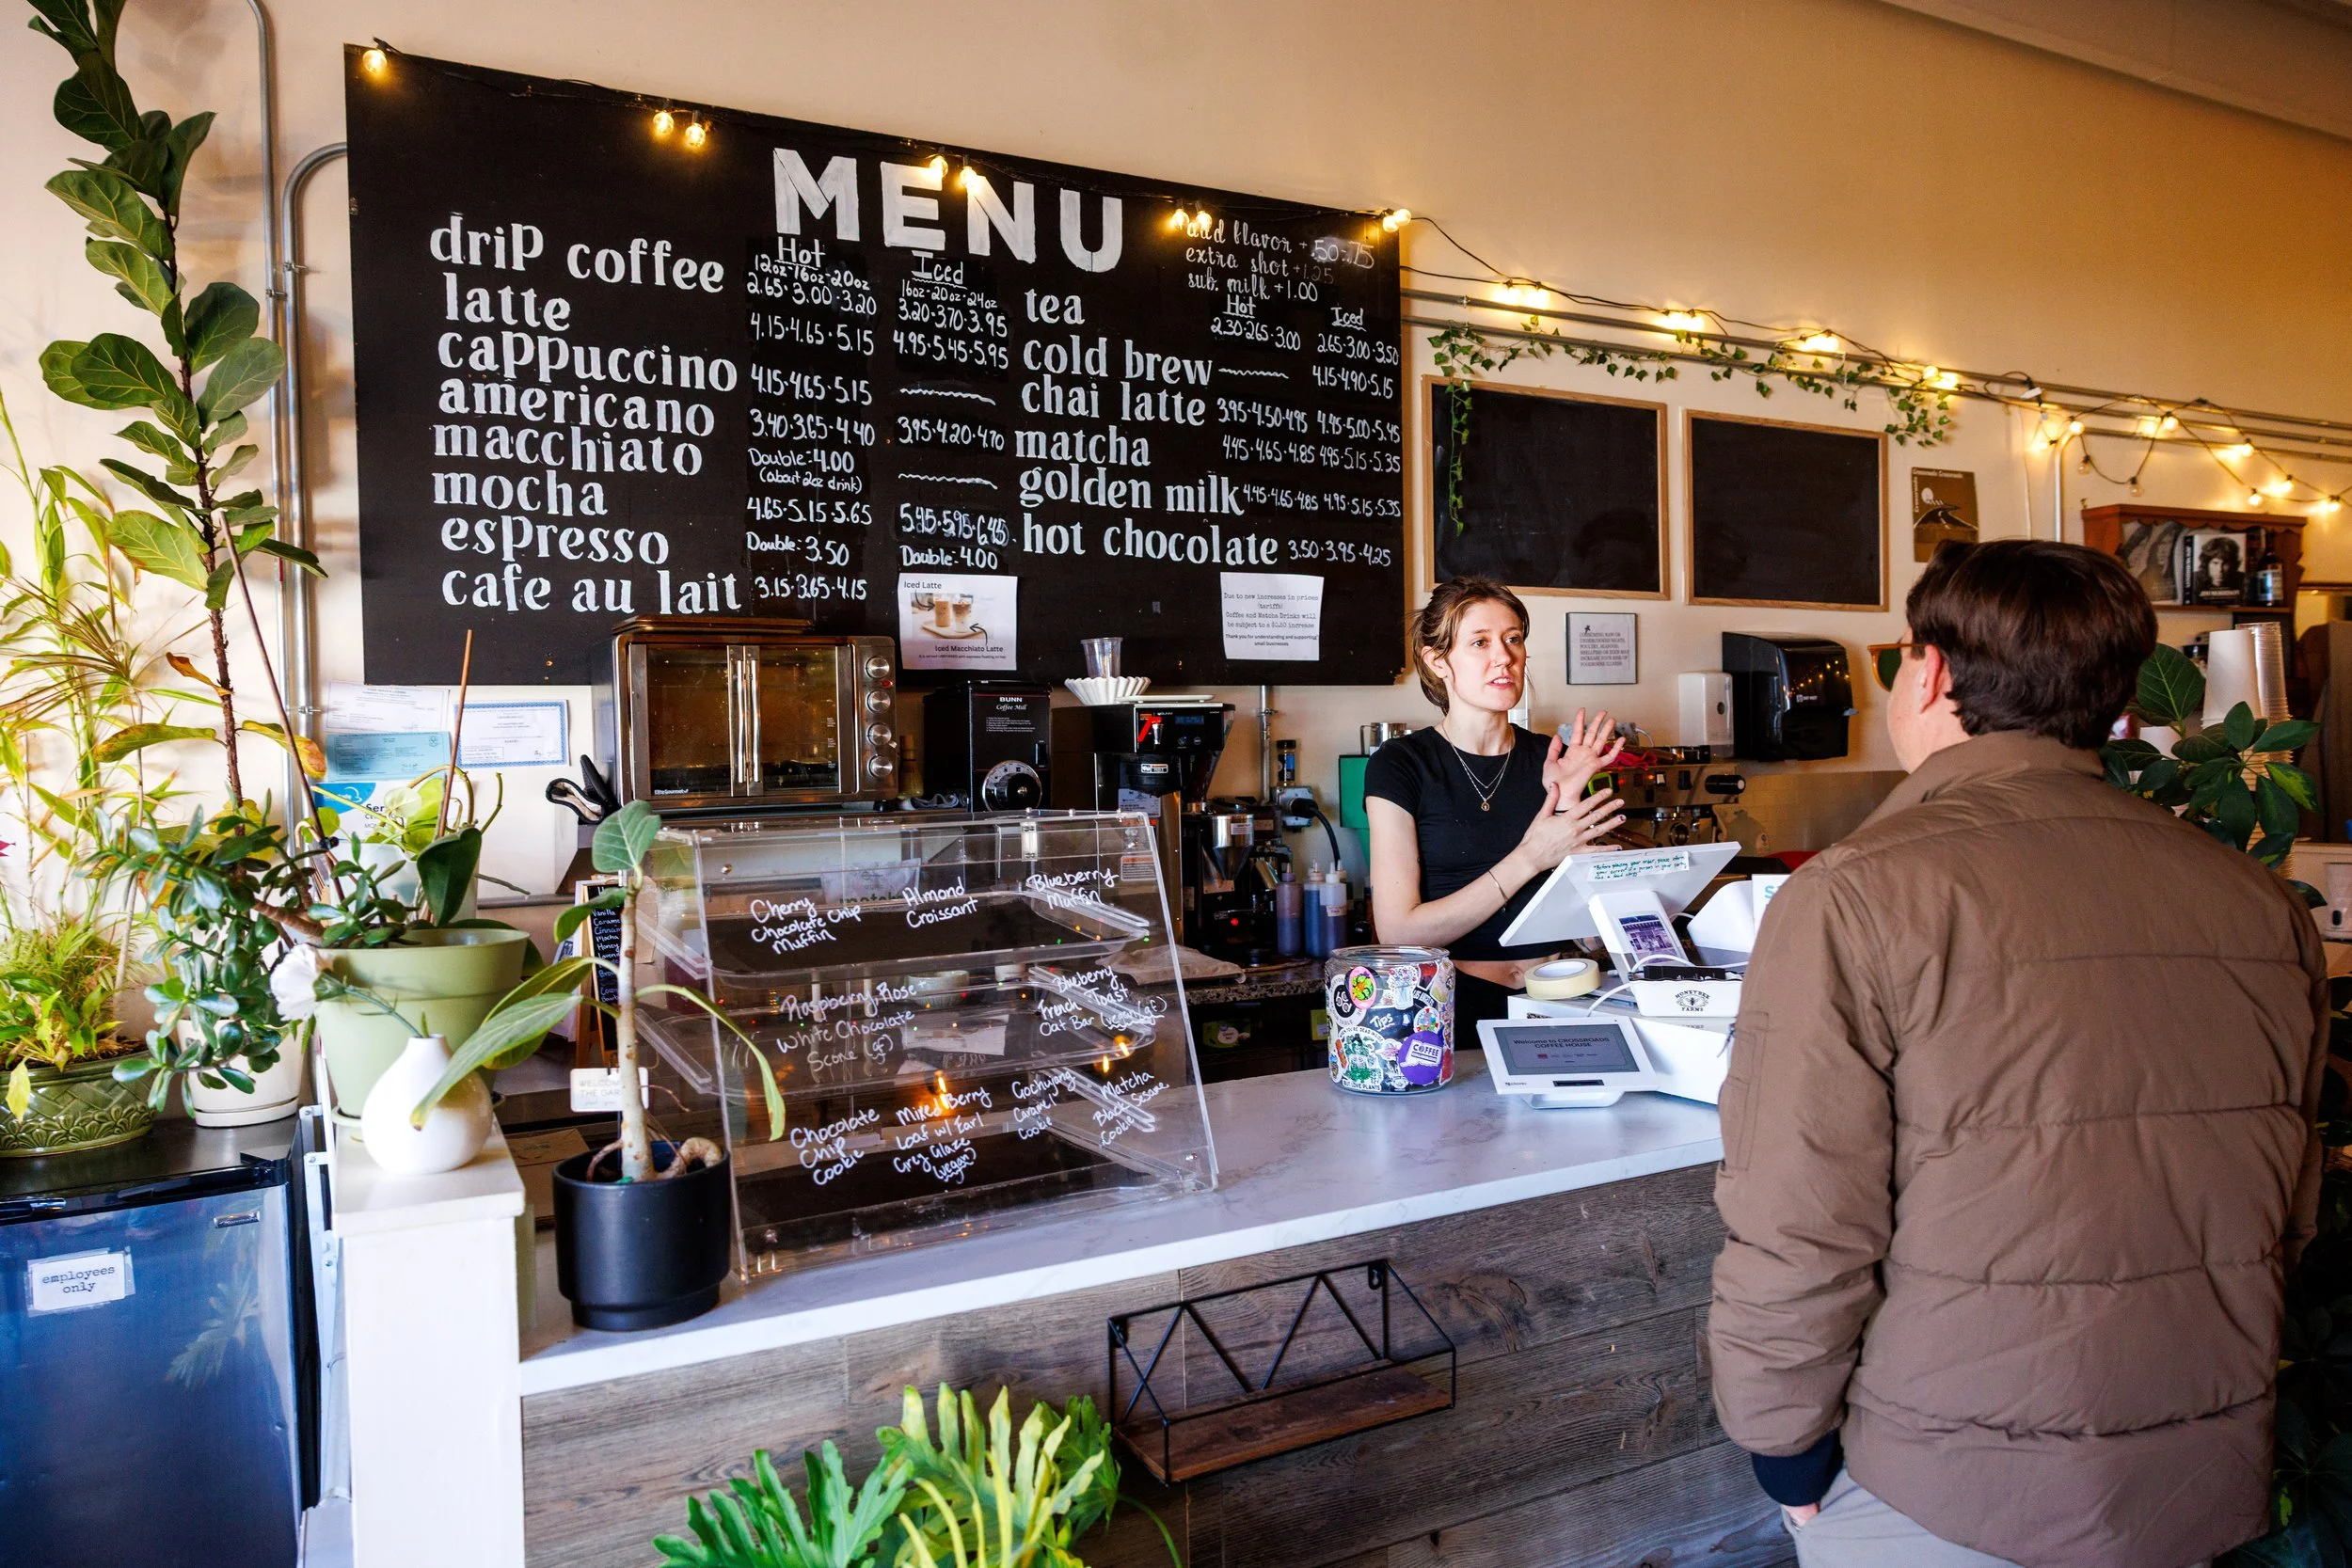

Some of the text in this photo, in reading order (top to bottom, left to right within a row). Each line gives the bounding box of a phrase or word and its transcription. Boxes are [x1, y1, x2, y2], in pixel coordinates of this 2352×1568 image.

[771, 147, 1124, 274] MENU
[430, 212, 723, 293] drip coffee
[778, 237, 825, 267] Hot
[1233, 221, 1293, 254] flavor
[912, 250, 962, 284] Iced
[1185, 246, 1239, 269] extra
[1250, 251, 1290, 277] shot
[443, 273, 570, 331] latte
[1227, 274, 1271, 300] milk
[1025, 289, 1085, 325] tea
[1226, 294, 1256, 315] Hot
[1330, 307, 1364, 325] Iced
[438, 330, 737, 393] cappuccino
[1024, 336, 1212, 387] cold brew
[437, 377, 716, 438] americano
[1022, 374, 1206, 425] chai latte
[433, 423, 704, 477] macchiato
[1015, 425, 1151, 467] matcha
[433, 470, 608, 517] mocha
[828, 472, 864, 494] drink)
[1020, 463, 1244, 515] golden milk
[441, 515, 669, 564] espresso
[805, 536, 849, 565] 3.50
[1024, 513, 1278, 565] hot chocolate
[442, 564, 741, 614] cafe au lait
[904, 580, 942, 590] Iced Latte
[995, 704, 1013, 712] Coffee
[902, 877, 966, 908] Almond
[1026, 868, 1120, 894] Blueberry
[592, 908, 616, 917] Vanilla
[750, 896, 818, 924] Cherry
[906, 896, 978, 928] Croissant
[1047, 887, 1104, 911] Muffin
[596, 934, 619, 942] Mocha
[751, 904, 862, 943] Chocolate Chip
[597, 943, 621, 953] Honey
[771, 927, 837, 955] Muffin
[876, 981, 917, 1004] Rose
[1052, 965, 1119, 994] Blueberry
[1038, 983, 1130, 1022] French Toast
[776, 1008, 915, 1053] White Chocolate
[1039, 1021, 1067, 1037] Oat
[1072, 1016, 1095, 1031] Bar
[806, 1050, 859, 1072] Scone
[1412, 1043, 1439, 1057] COFFEE
[1011, 1069, 1076, 1101] Gochujang
[1100, 1071, 1155, 1101] Matcha
[896, 1086, 993, 1127] Mixed Berry
[1013, 1093, 1057, 1125] Caramel
[1093, 1083, 1170, 1128] Black Sesame
[790, 1106, 881, 1149] Chocolate
[896, 1124, 929, 1151] Loaf
[954, 1114, 985, 1134] Earl
[1017, 1117, 1053, 1141] Cookie
[1101, 1117, 1136, 1147] Cookie
[799, 1136, 847, 1170] Chip
[813, 1148, 865, 1186] Cookie
[894, 1136, 971, 1174] Grey Glaze
[41, 1266, 115, 1284] employees
[62, 1282, 96, 1294] only
